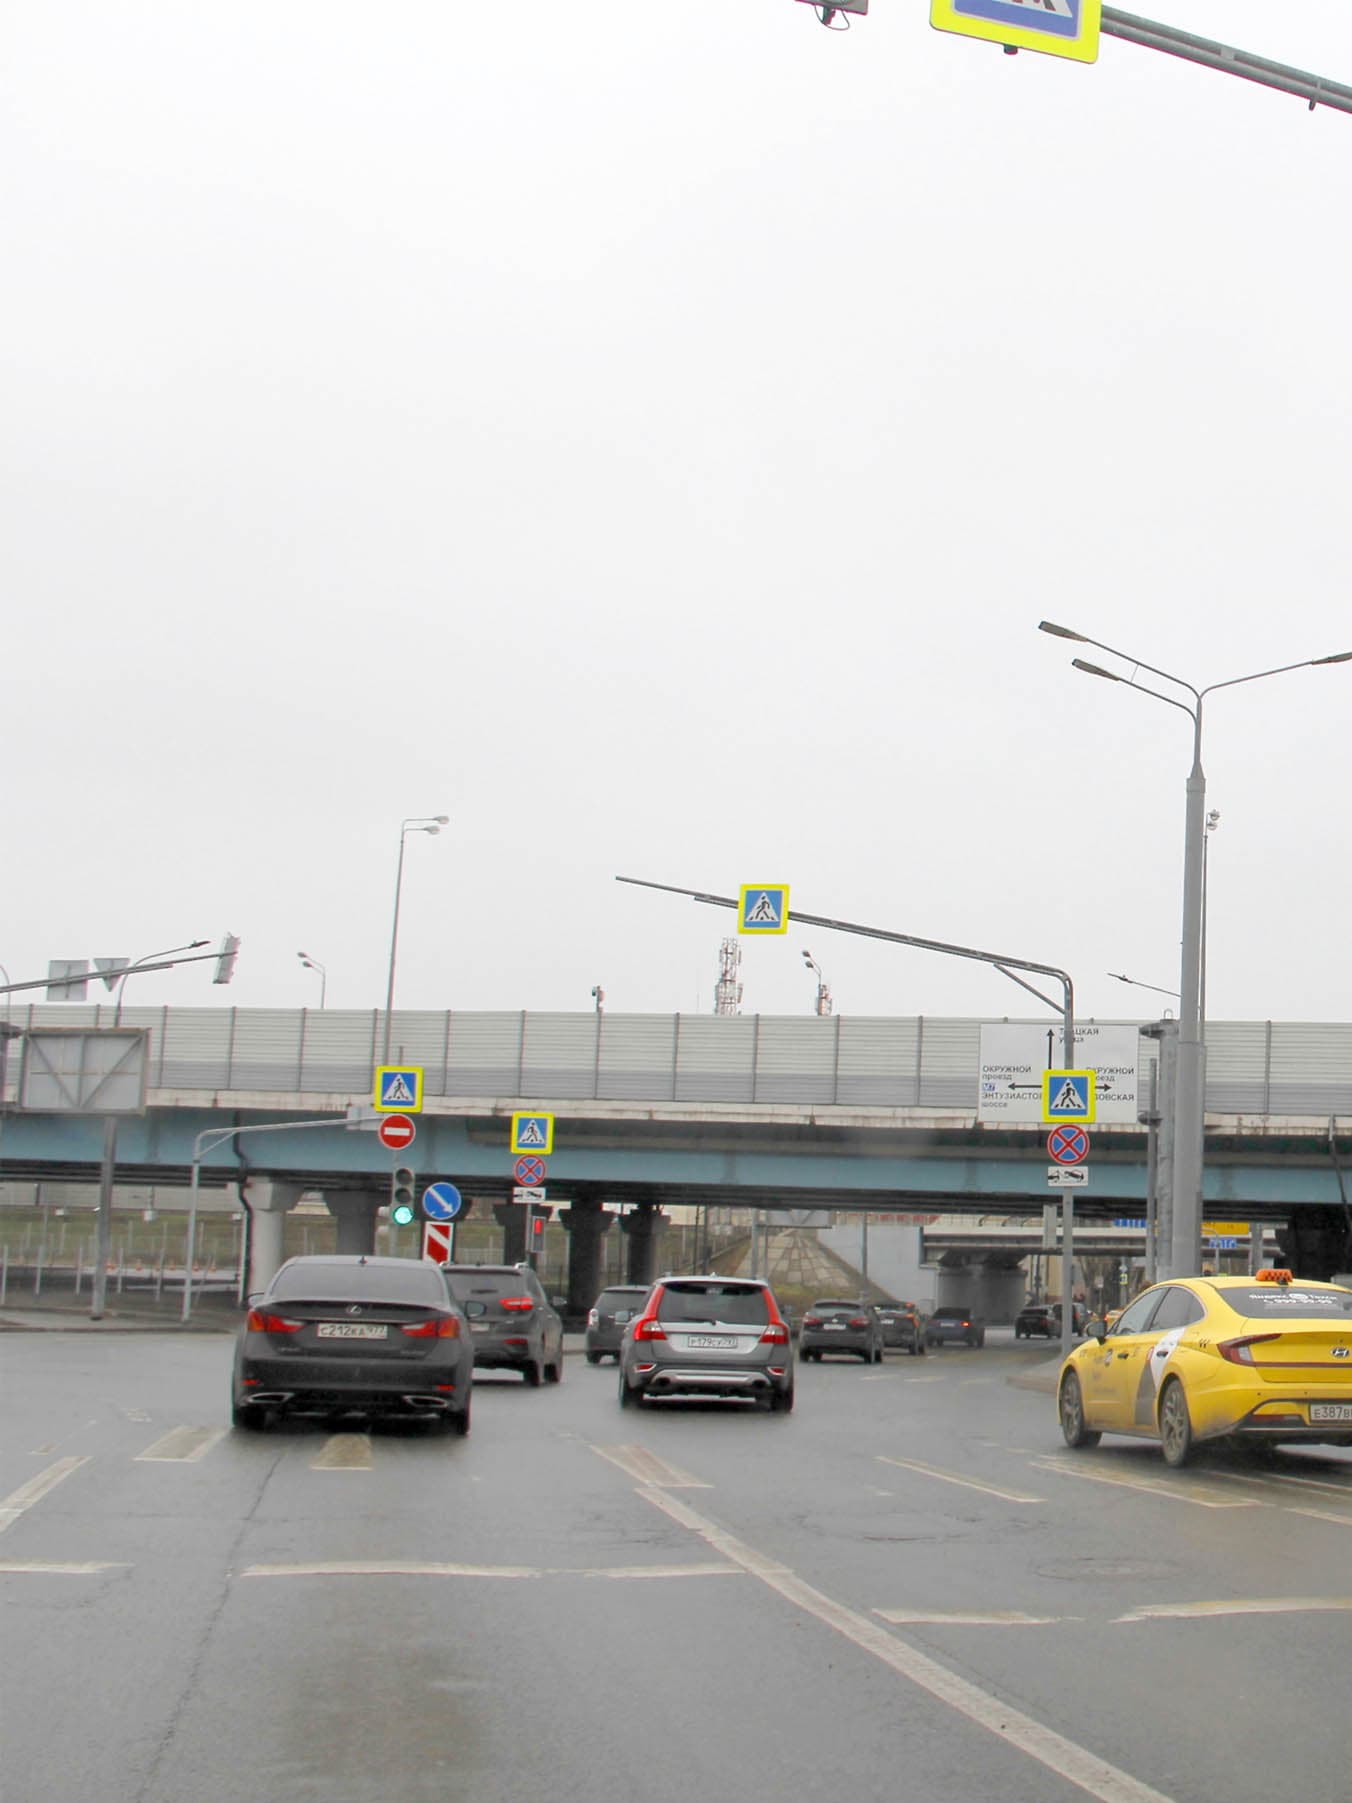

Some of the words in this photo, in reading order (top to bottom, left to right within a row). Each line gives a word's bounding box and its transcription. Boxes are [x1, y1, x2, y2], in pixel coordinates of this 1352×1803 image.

[1059, 1028, 1099, 1036] ТЦКАЯ
[982, 1065, 1031, 1073] ОКРУЖНОЙ
[1087, 1066, 1135, 1075] РУЖНОЙ
[982, 1093, 1043, 1101] ЭНТУЗИАСТО
